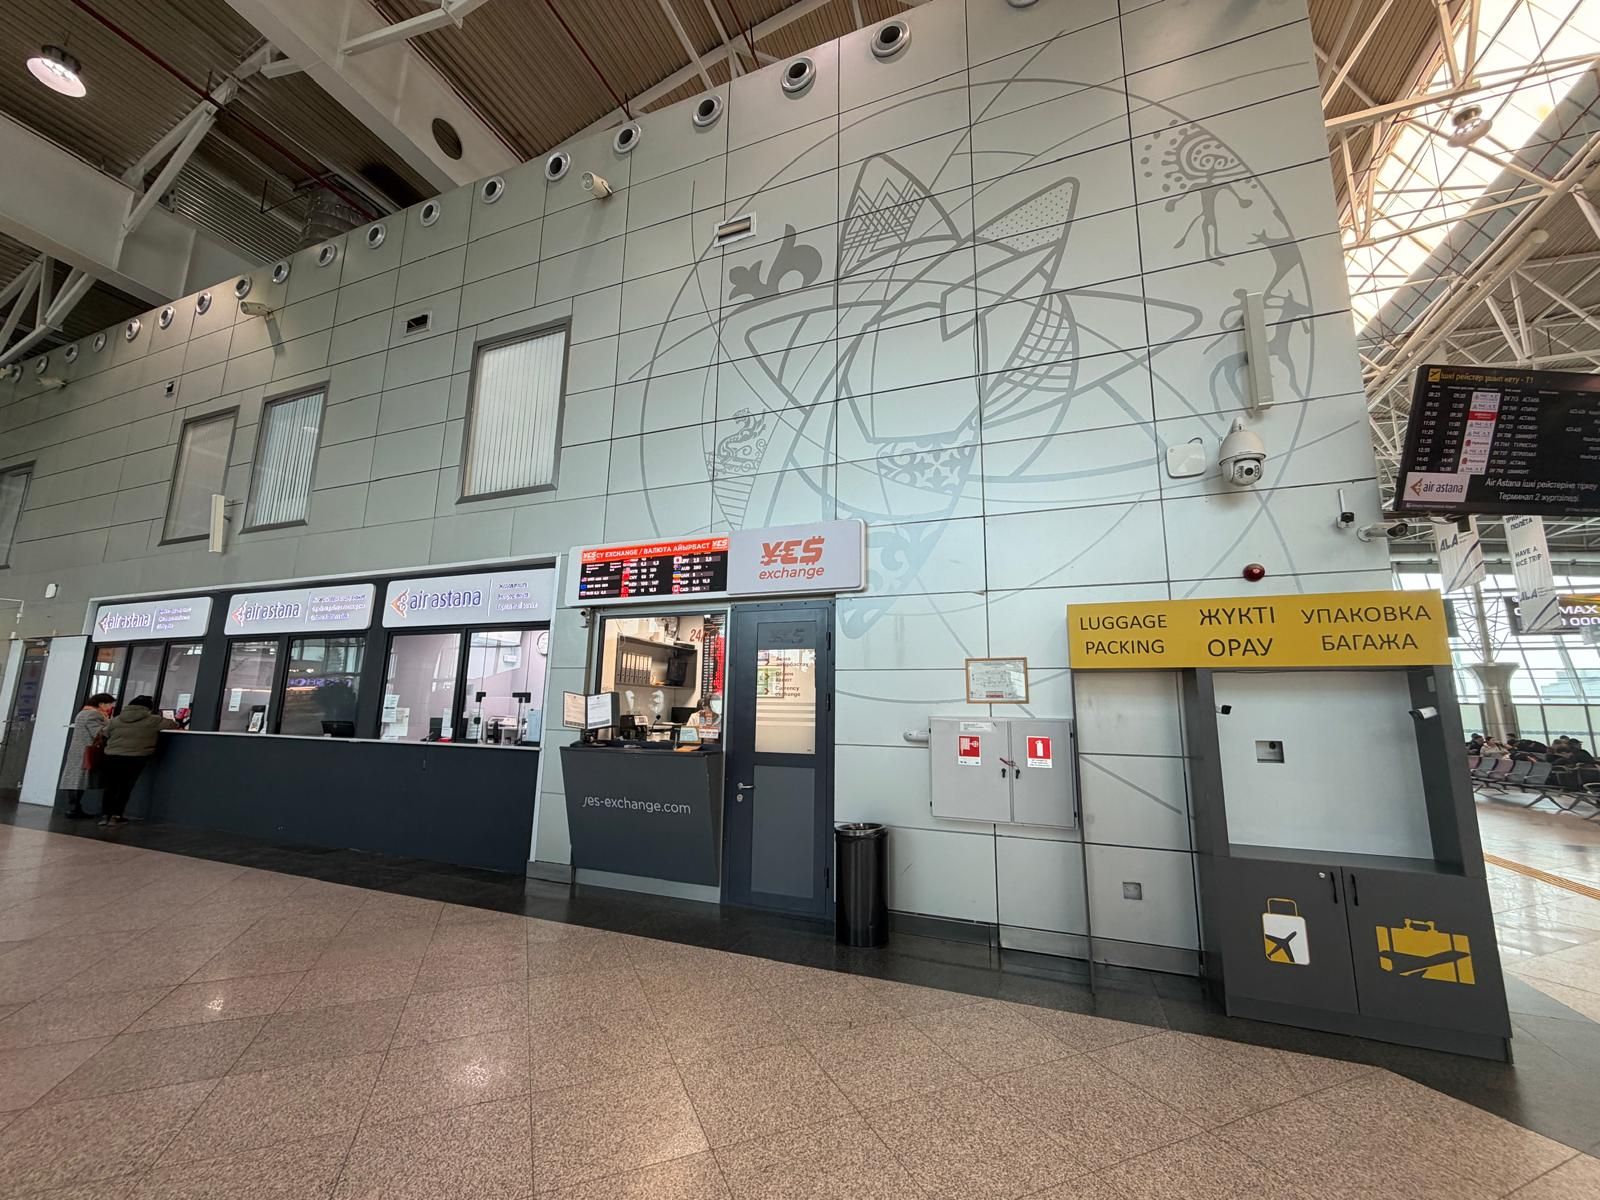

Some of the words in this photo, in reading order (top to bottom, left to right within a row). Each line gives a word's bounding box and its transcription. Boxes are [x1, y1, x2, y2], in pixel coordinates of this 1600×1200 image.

[1422, 481, 1435, 493] air
[1435, 482, 1464, 494] astana
[1485, 478, 1495, 486] Air
[1496, 478, 1521, 488] Astana
[1498, 491, 1534, 501] Терминал
[1534, 493, 1541, 501] 2
[1440, 533, 1459, 551] ALA
[605, 549, 639, 558] EXCHANGE
[643, 546, 672, 555] ВАЛЮТА
[1515, 548, 1531, 559] HAVE
[759, 567, 825, 580] exchange
[409, 590, 430, 610] air
[431, 588, 482, 608] astana
[245, 602, 261, 621] air
[261, 601, 301, 619] astana
[1200, 606, 1276, 625] ЖҮКТІ
[1301, 604, 1432, 625] УПАКОВКА
[107, 613, 121, 630] air
[121, 612, 151, 629] astana
[1080, 614, 1168, 631] LUGGAGE
[1085, 639, 1166, 655] PACKING
[1207, 637, 1274, 657] ОРАУ
[1321, 633, 1419, 652] БАГАЖА
